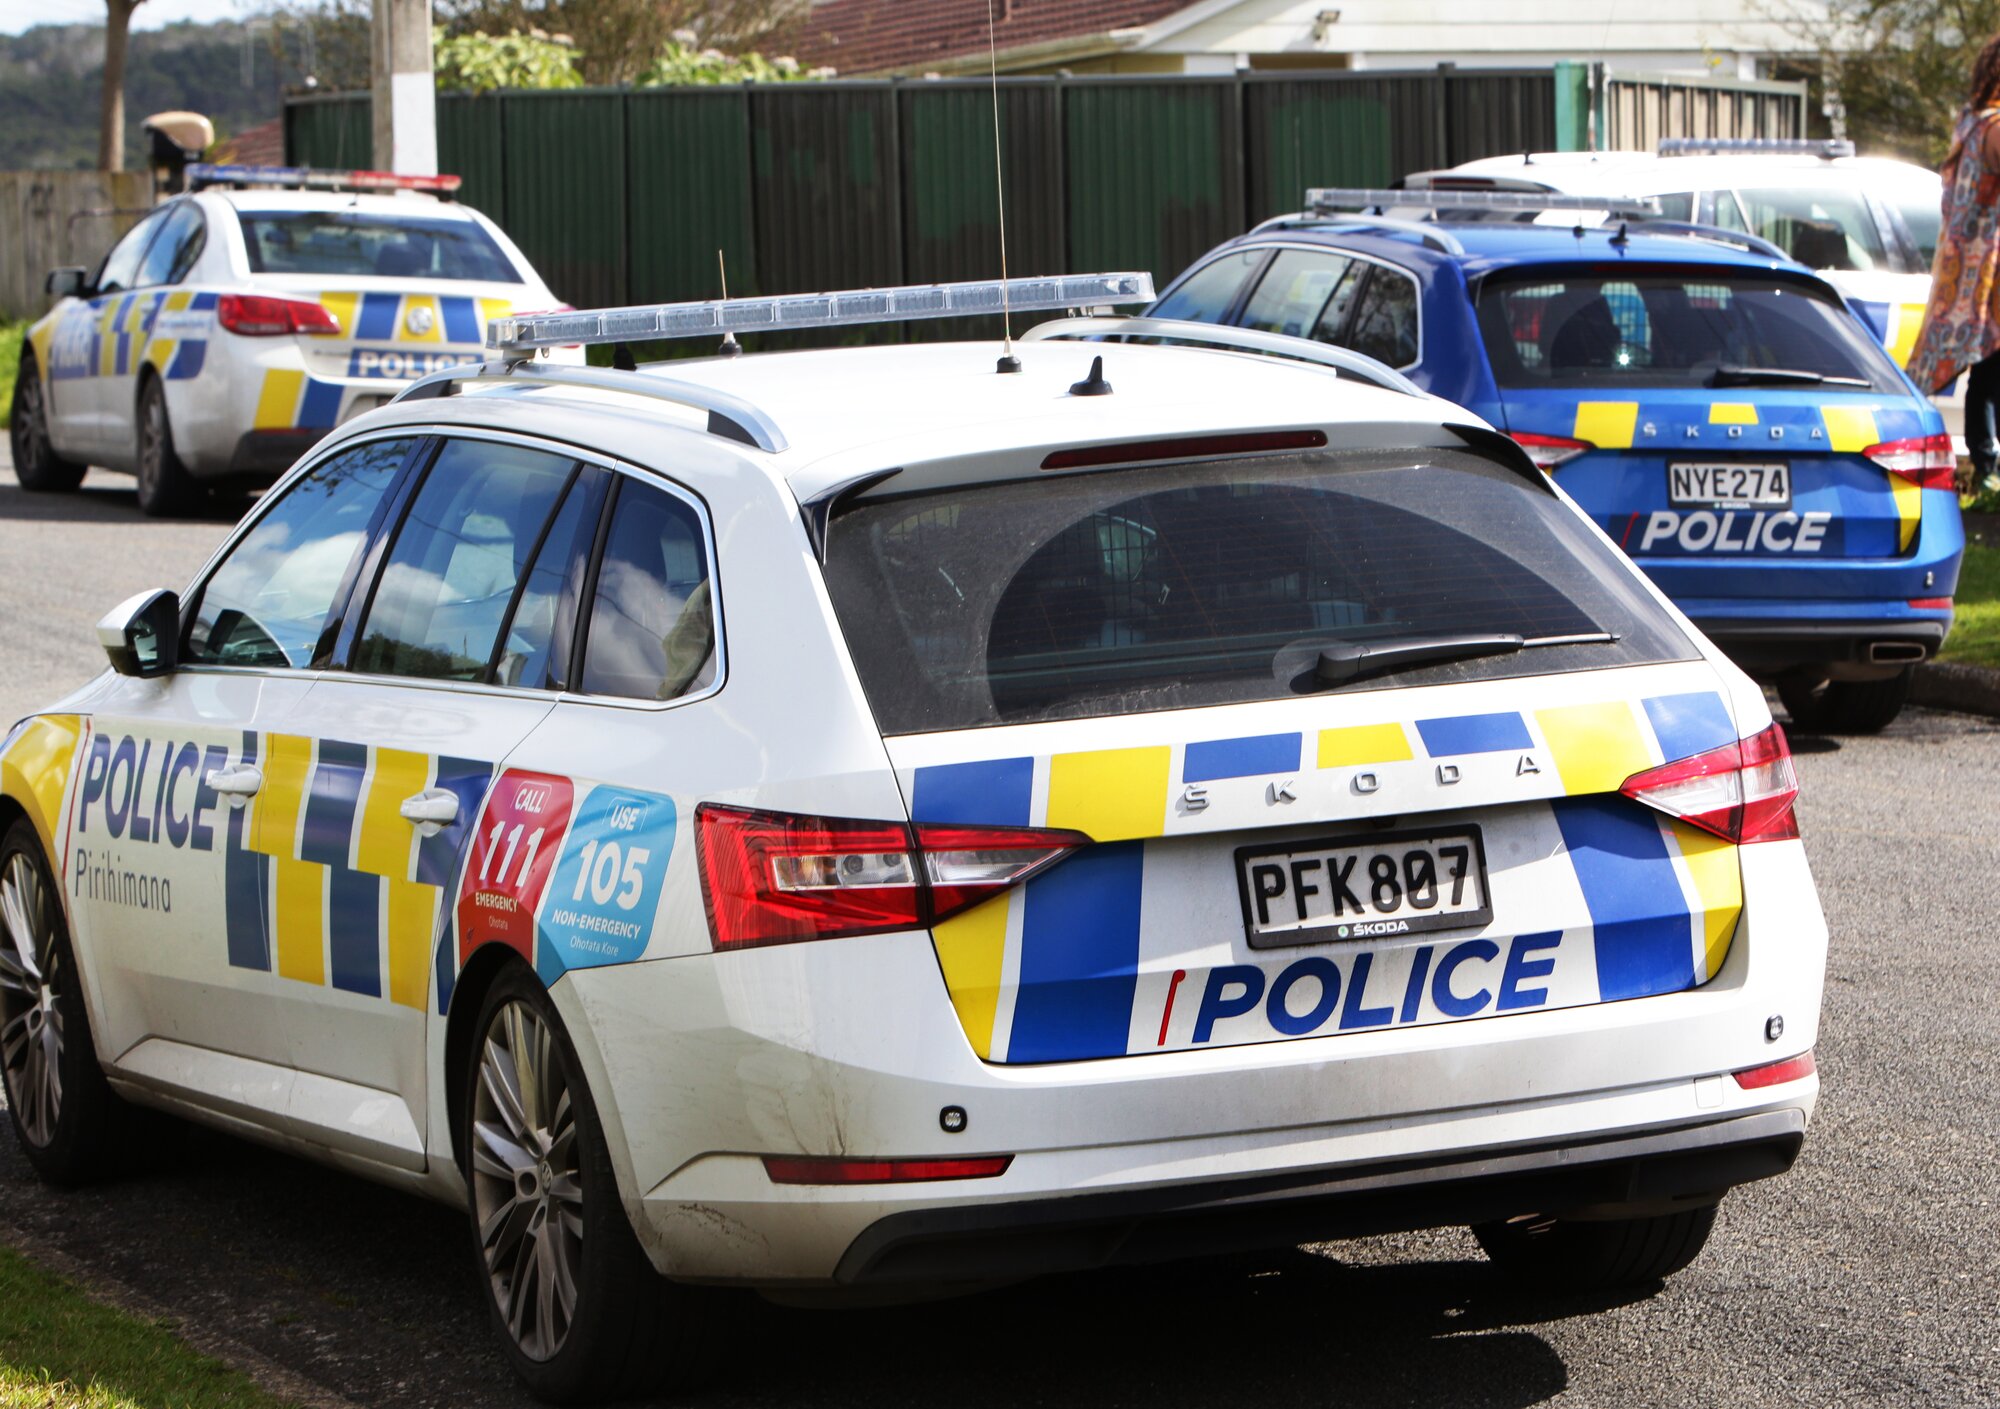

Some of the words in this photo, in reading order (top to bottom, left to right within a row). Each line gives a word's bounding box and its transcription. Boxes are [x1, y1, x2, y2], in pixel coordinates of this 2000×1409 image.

[1673, 468, 1786, 498] NYE274
[1640, 511, 1832, 552] POLICE
[78, 733, 229, 852] POLICE
[515, 788, 544, 812] CALL
[611, 805, 639, 830] USE
[479, 821, 545, 887] 111
[75, 848, 171, 913] Pirihimana
[572, 839, 650, 911] 105
[1252, 845, 1470, 925] PFK807
[475, 891, 519, 913] EMERGENCY
[552, 909, 642, 940] NON-EMERGENCY
[1353, 921, 1409, 937] ŠKODA
[570, 935, 602, 951] Ohotata
[602, 942, 619, 956] Kore
[1191, 930, 1564, 1044] POLICE
